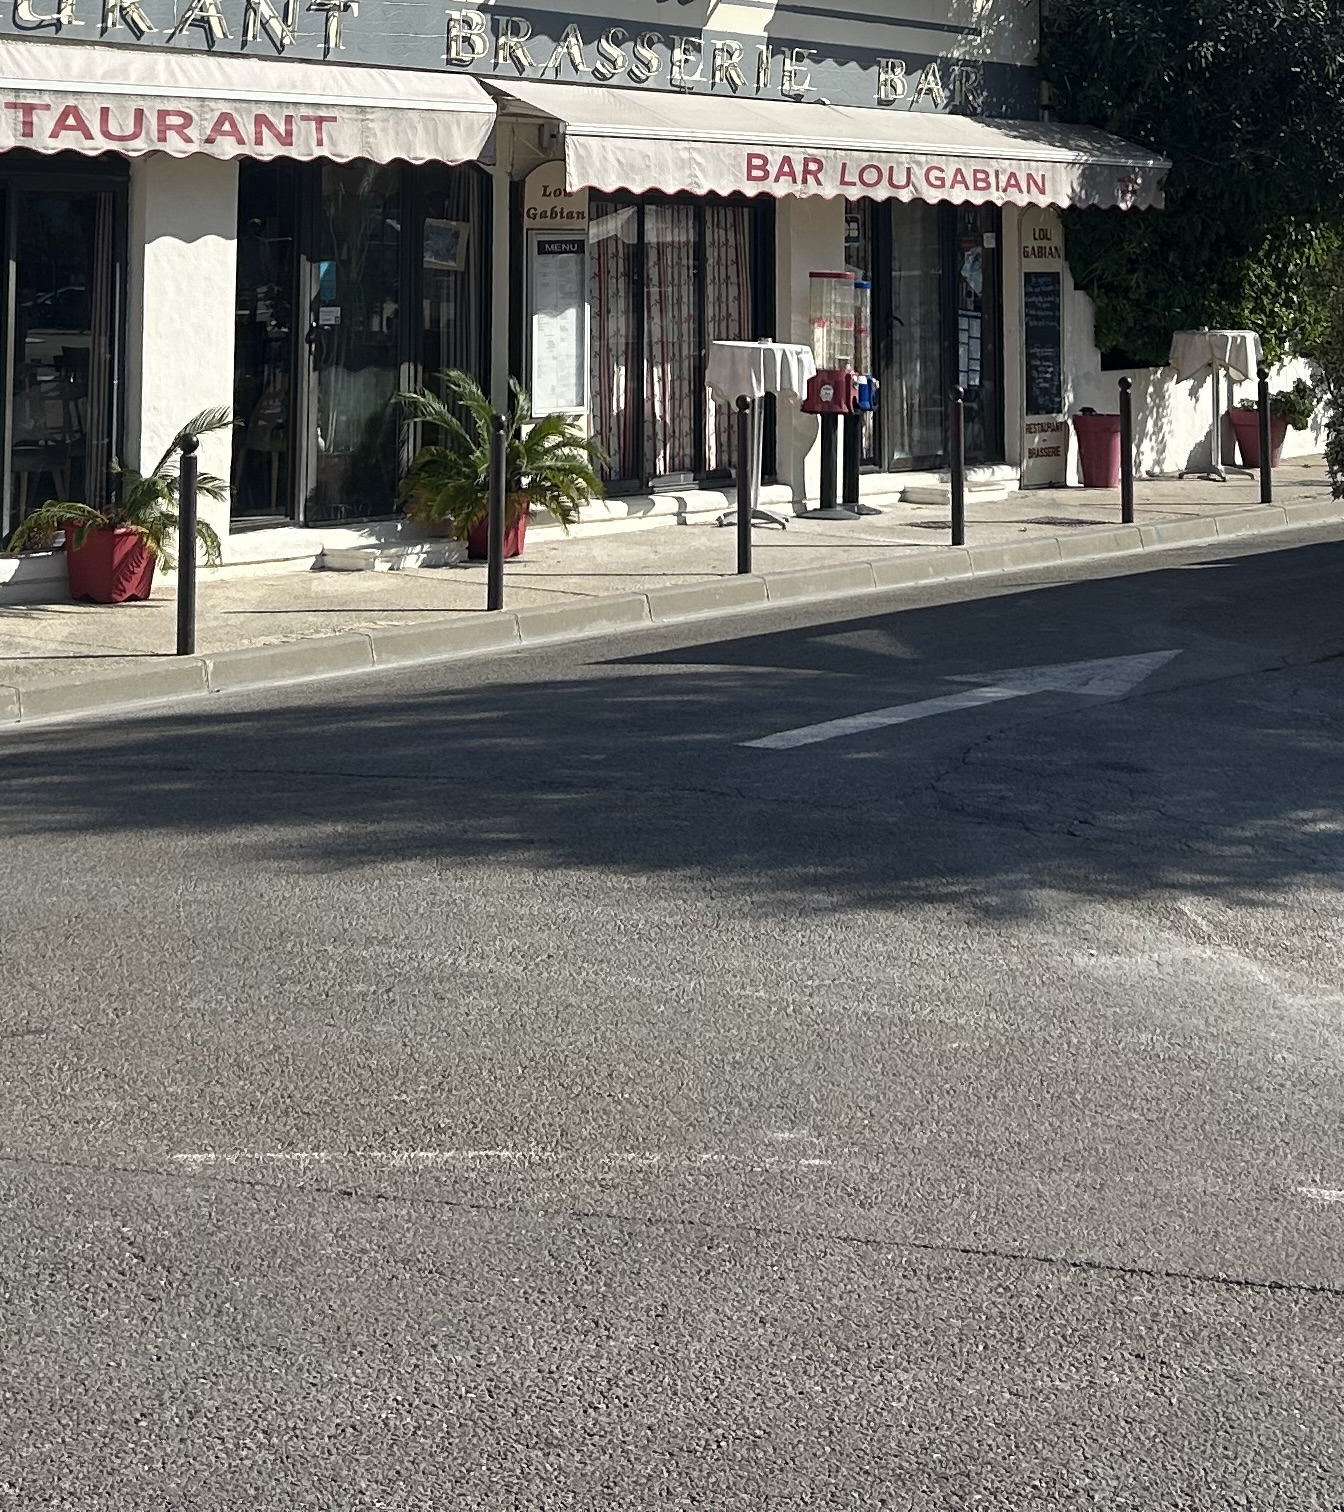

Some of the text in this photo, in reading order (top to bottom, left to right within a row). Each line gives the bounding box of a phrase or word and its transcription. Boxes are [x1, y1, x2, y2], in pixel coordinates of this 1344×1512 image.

[441, 8, 818, 99] BRASSERIE
[873, 56, 984, 113] BAR
[745, 152, 1047, 197] BAR LOU GABIAN
[526, 205, 587, 221] Gabian
[1032, 227, 1052, 241] LOU
[544, 242, 578, 253] MENU
[1022, 245, 1062, 259] GABIAN
[1027, 445, 1062, 460] BRASSERIE
